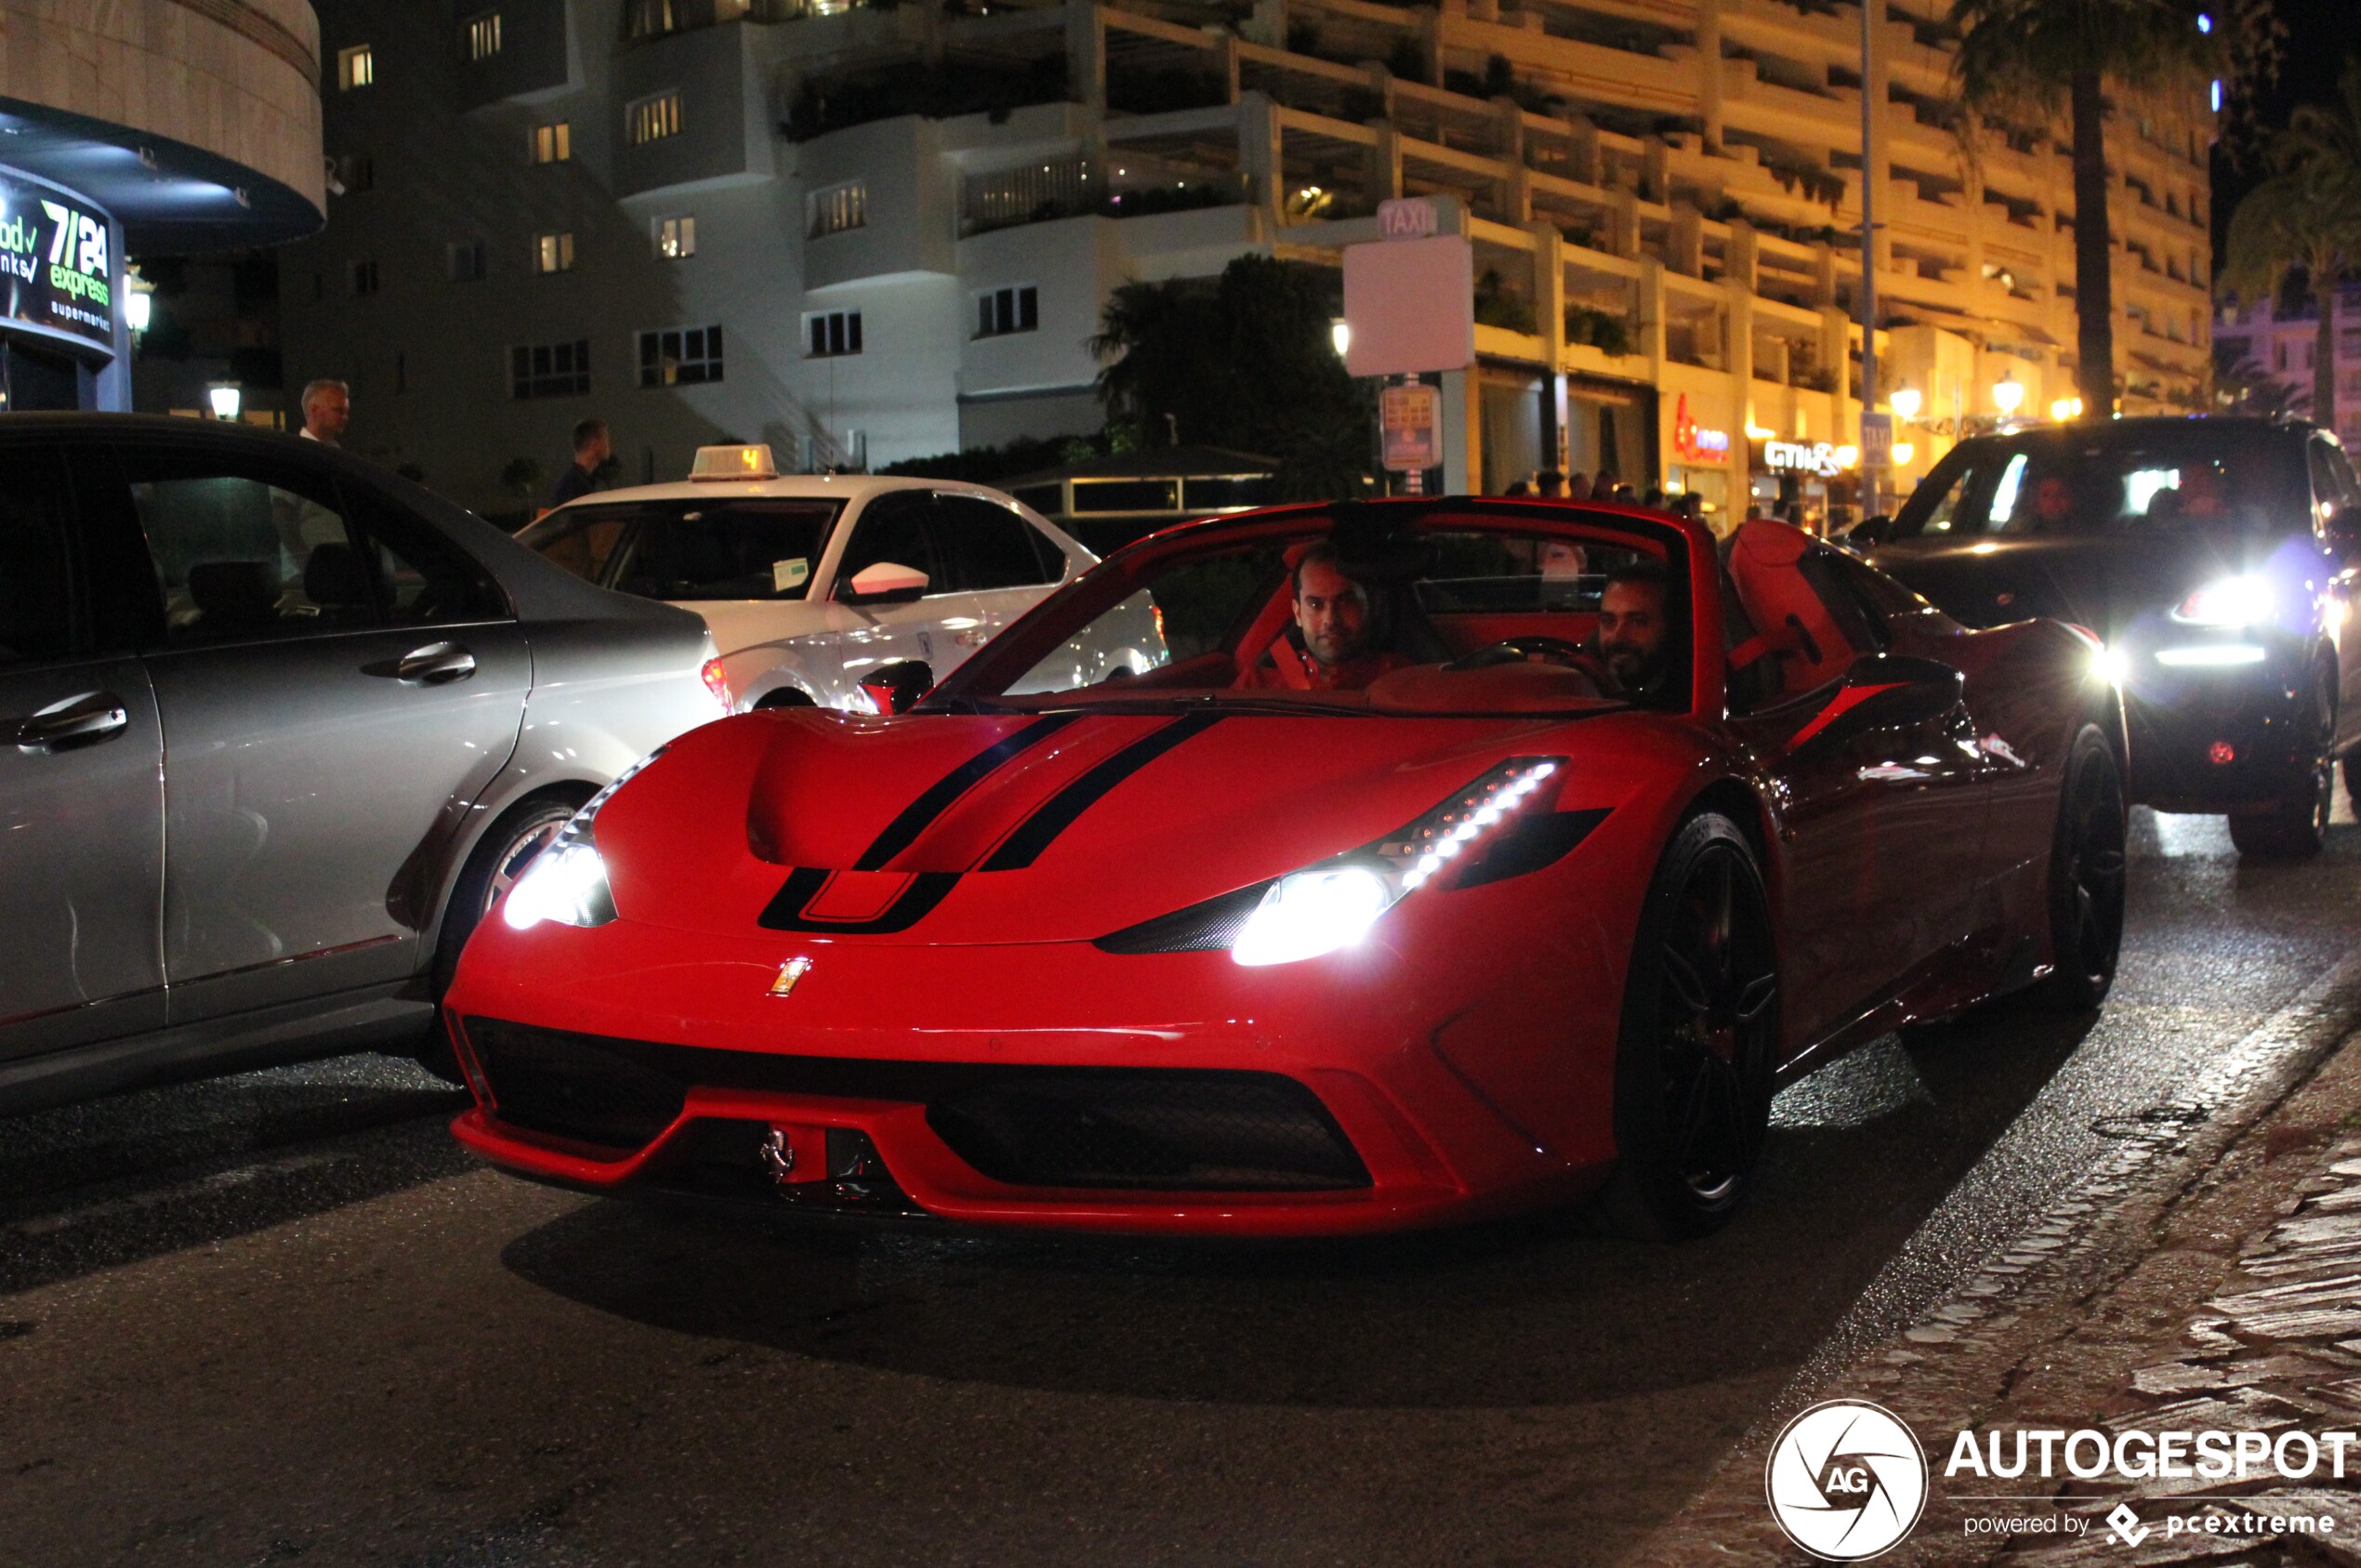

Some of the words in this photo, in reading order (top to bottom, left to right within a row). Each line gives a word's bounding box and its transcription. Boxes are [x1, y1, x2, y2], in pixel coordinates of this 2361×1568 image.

[1380, 204, 1428, 233] TAXI
[41, 199, 109, 278] 7/24
[49, 264, 110, 307] express
[1863, 426, 1891, 451] TAXI
[743, 448, 758, 470] 4
